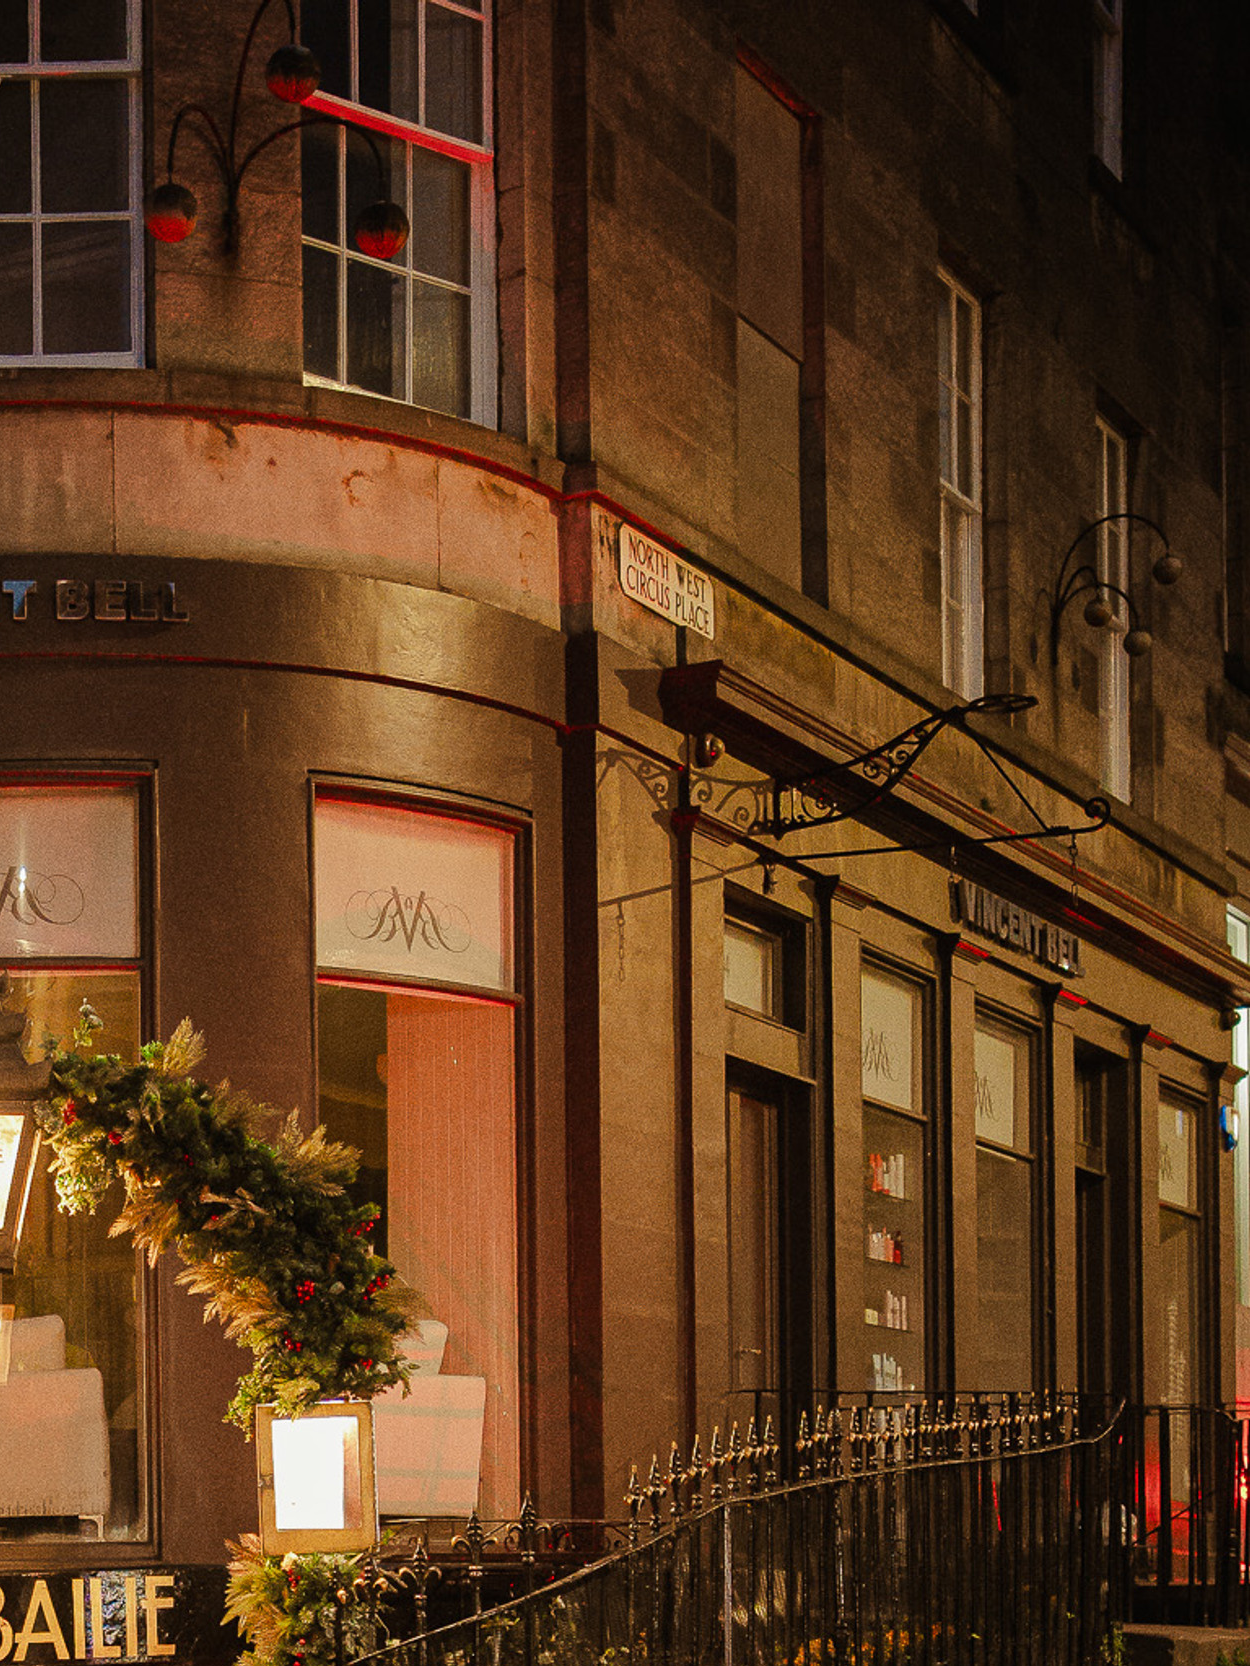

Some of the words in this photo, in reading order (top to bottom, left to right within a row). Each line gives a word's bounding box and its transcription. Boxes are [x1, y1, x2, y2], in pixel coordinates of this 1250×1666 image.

[55, 578, 190, 623] BELL
[626, 564, 670, 611] CIRCUS
[675, 591, 709, 635] PLACE
[628, 532, 669, 581] NORTH
[675, 561, 706, 603] WEST
[964, 877, 1048, 958] VINCENT
